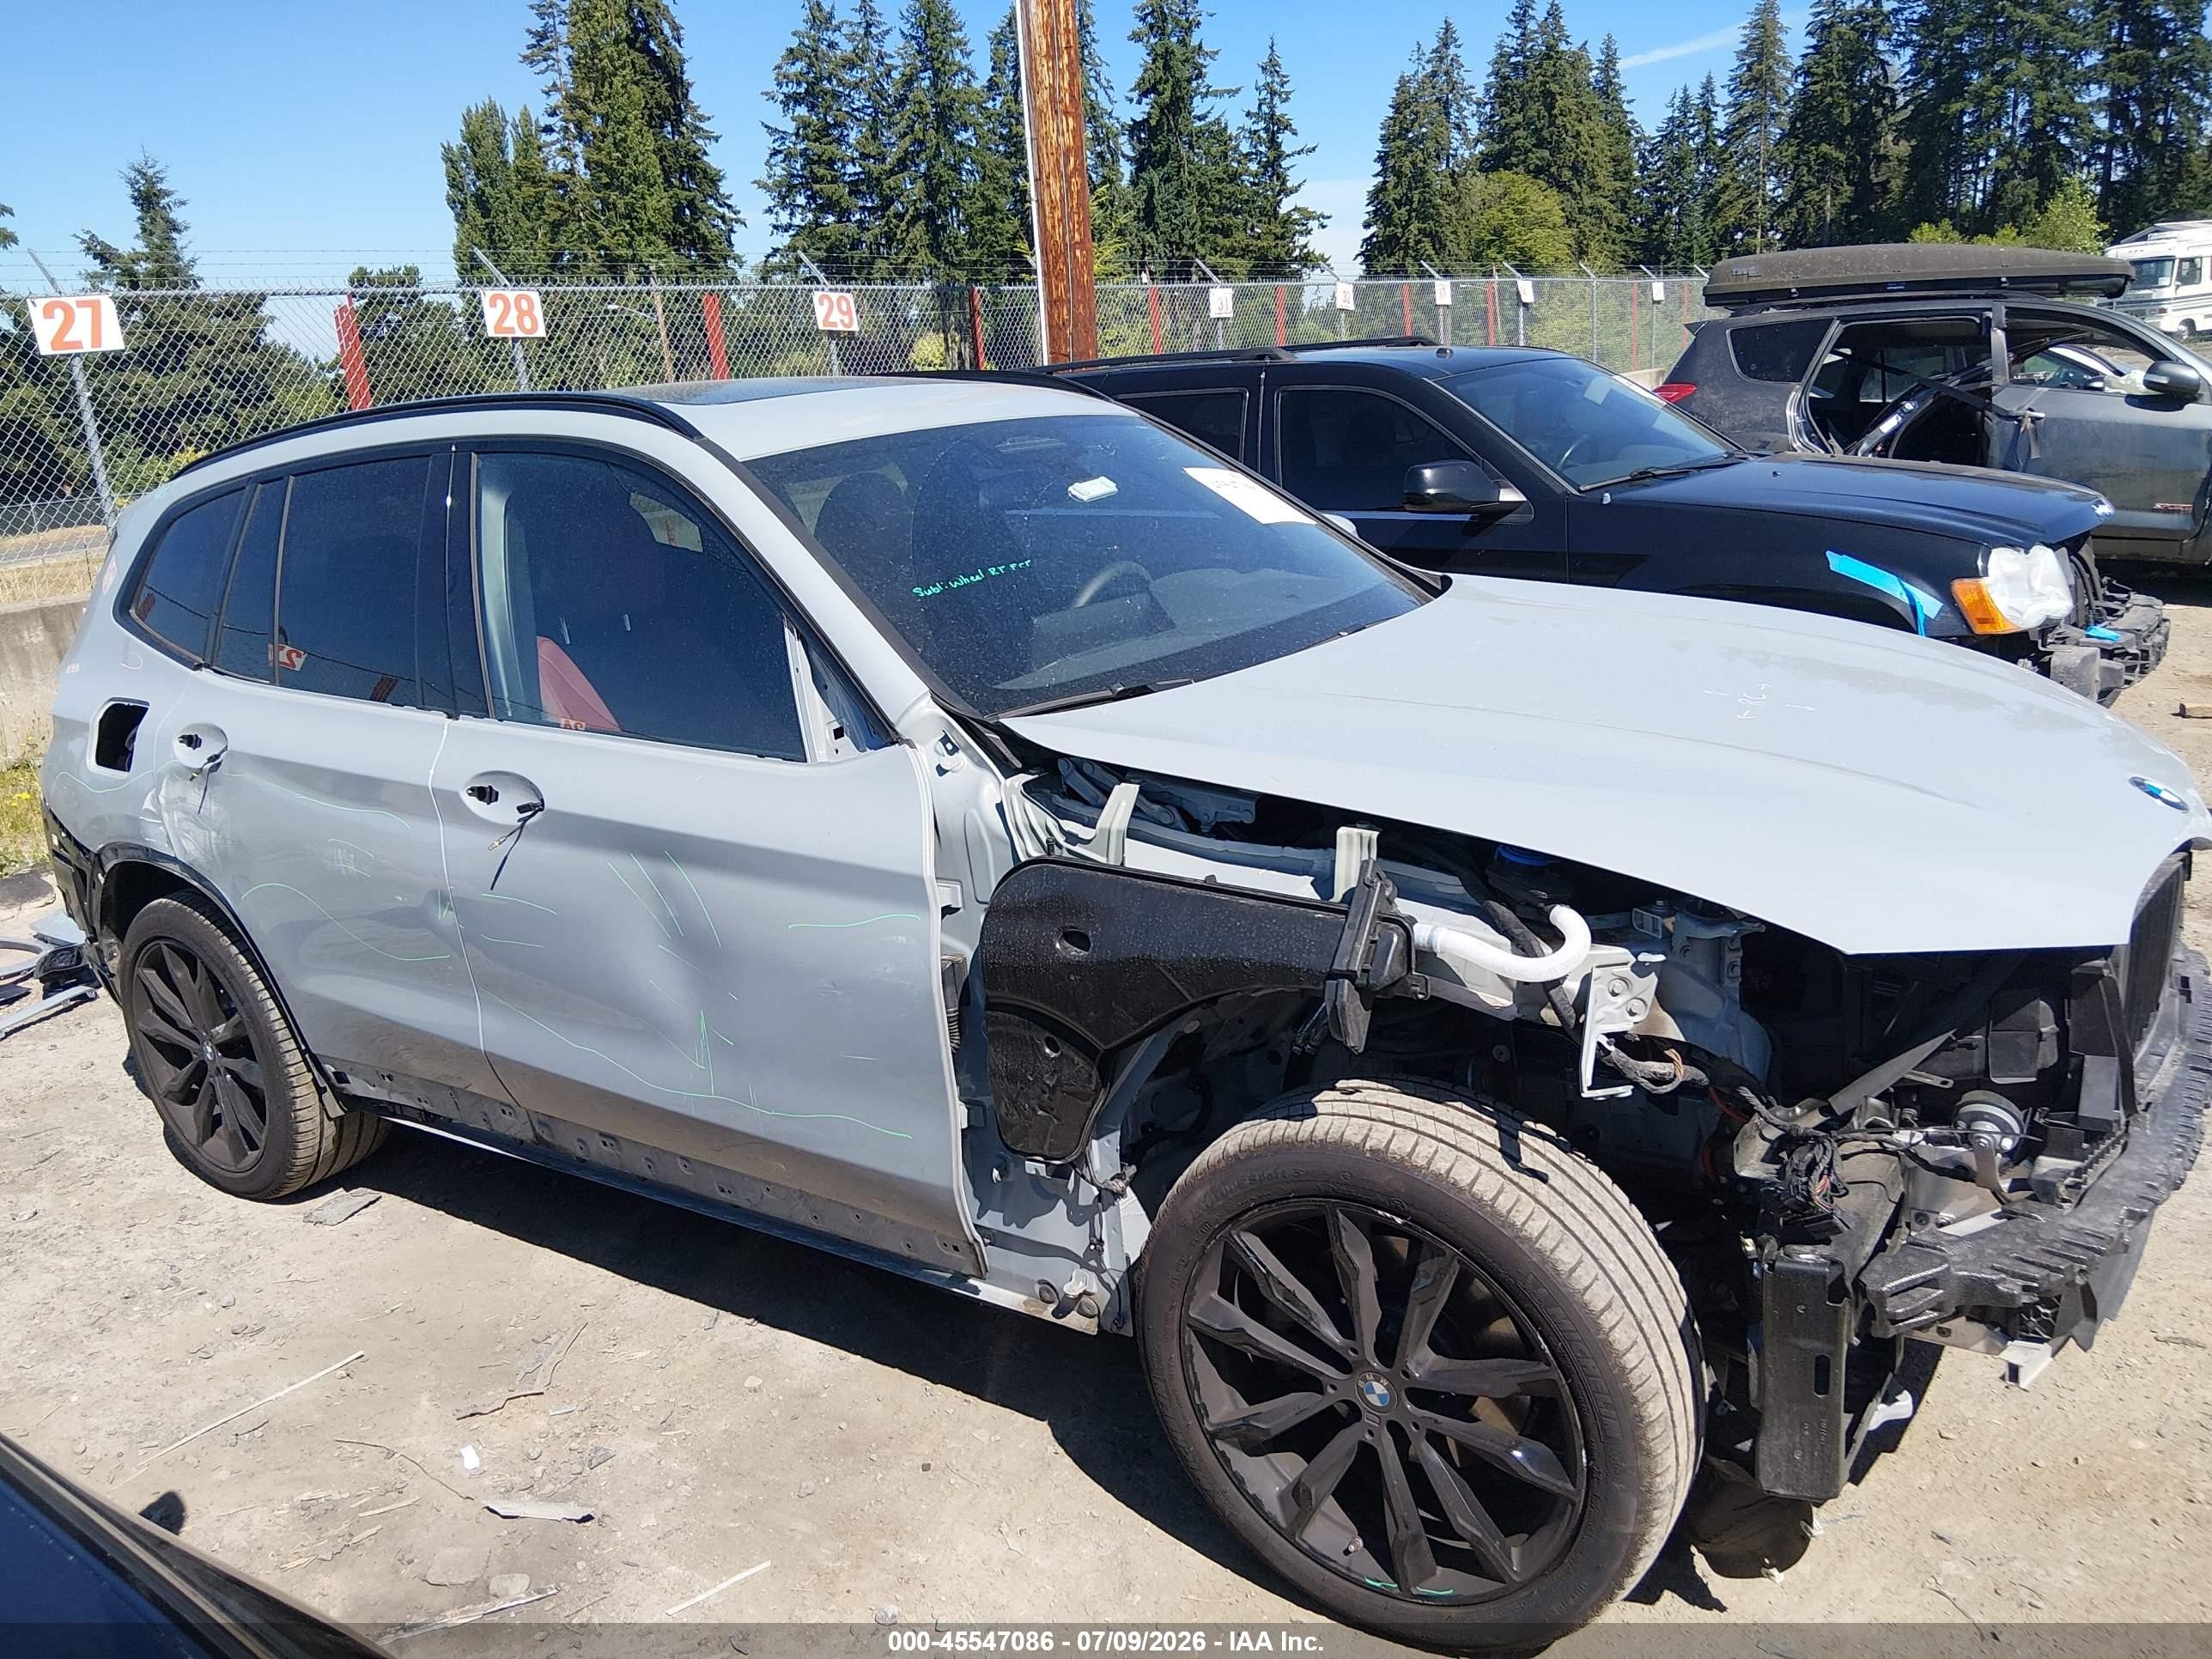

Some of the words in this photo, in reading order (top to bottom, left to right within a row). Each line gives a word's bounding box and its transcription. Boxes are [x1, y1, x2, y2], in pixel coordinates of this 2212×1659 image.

[42, 299, 102, 350] 27
[489, 293, 538, 334] 28
[817, 294, 854, 328] 29
[1358, 1373, 1389, 1389] BMW
